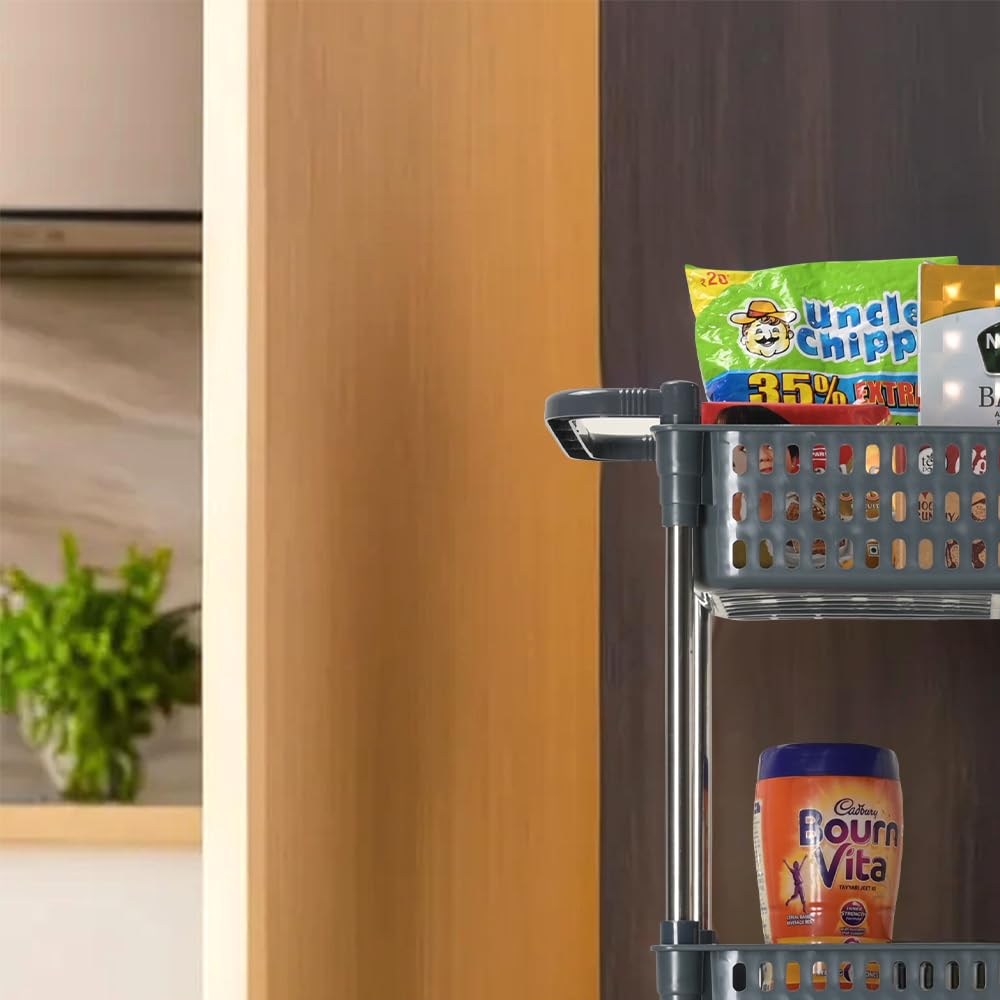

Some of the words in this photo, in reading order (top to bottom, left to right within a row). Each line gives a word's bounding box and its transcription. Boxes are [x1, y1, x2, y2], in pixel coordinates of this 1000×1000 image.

[804, 294, 918, 329] Uncle
[796, 328, 918, 363] Chipp
[748, 371, 848, 404] 35%
[854, 380, 919, 408] EXTR
[833, 798, 879, 818] Cadbury
[799, 808, 899, 847] Bourn
[815, 843, 887, 889] Vita
